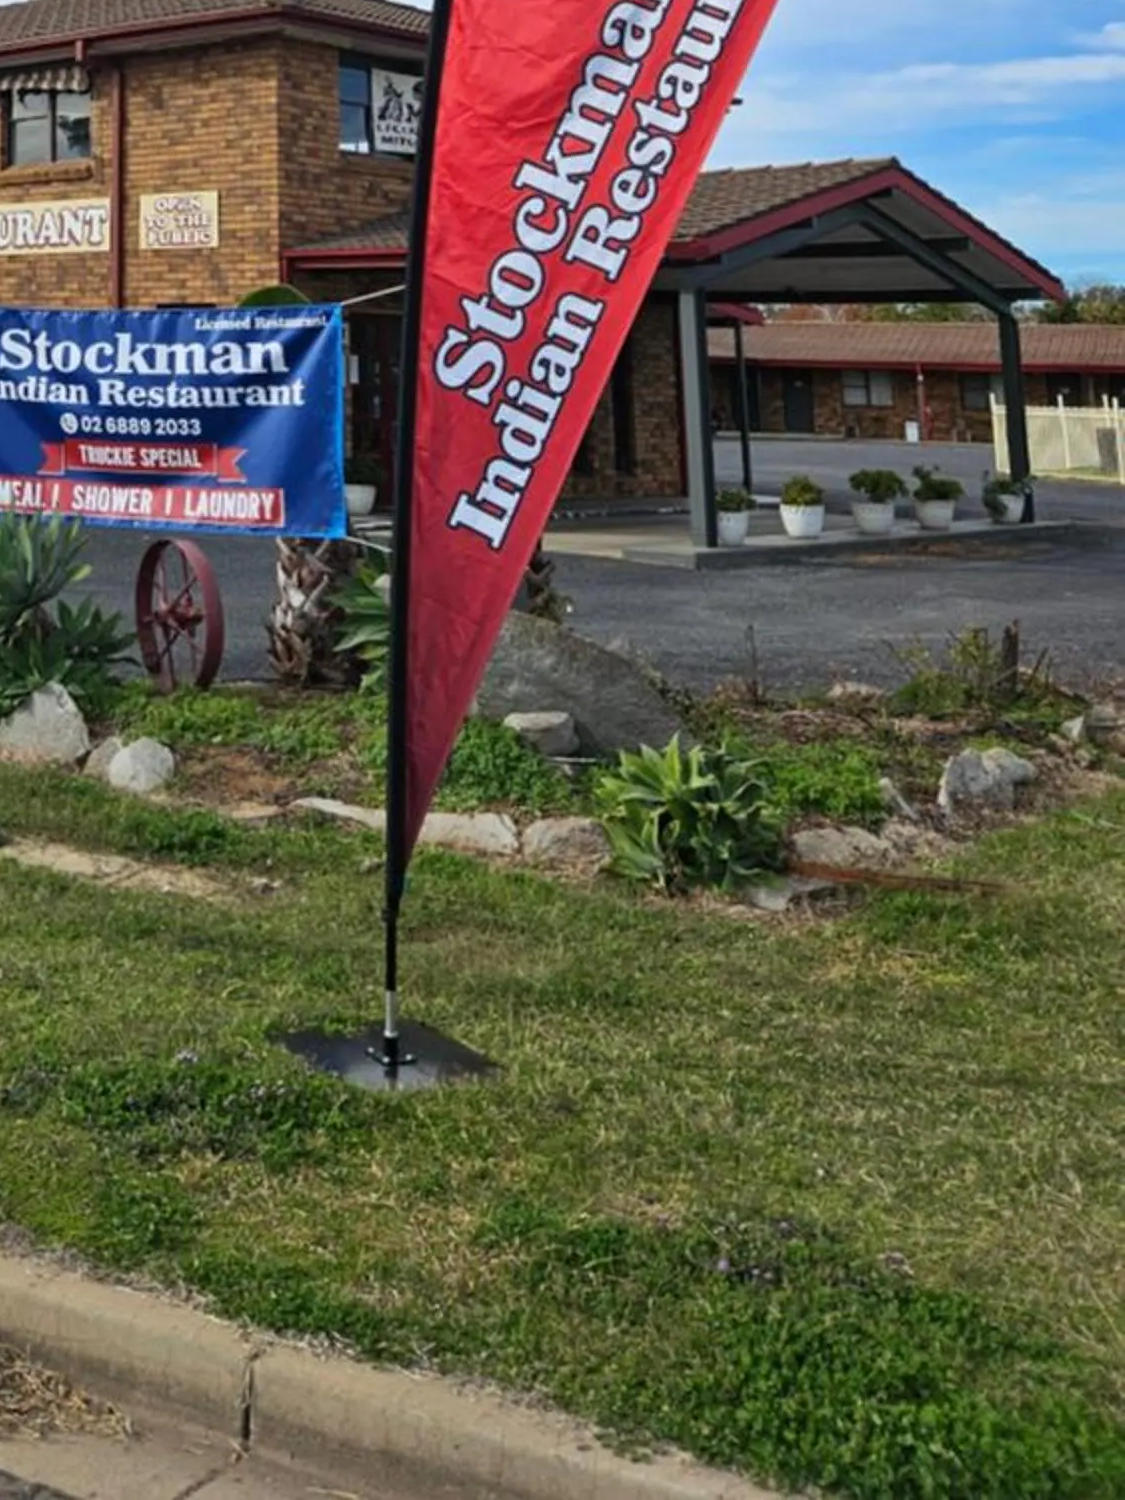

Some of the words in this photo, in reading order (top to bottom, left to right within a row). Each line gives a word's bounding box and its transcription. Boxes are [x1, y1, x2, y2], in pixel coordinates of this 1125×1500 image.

[97, 378, 306, 409] Restaurant
[80, 417, 102, 434] 02
[154, 418, 202, 436] 2033
[446, 290, 605, 550] Indian
[78, 443, 135, 466] TRUCKIE
[139, 445, 202, 469] SPECIAL
[71, 484, 153, 516] SHOWER
[184, 489, 276, 521] LAUNDRY
